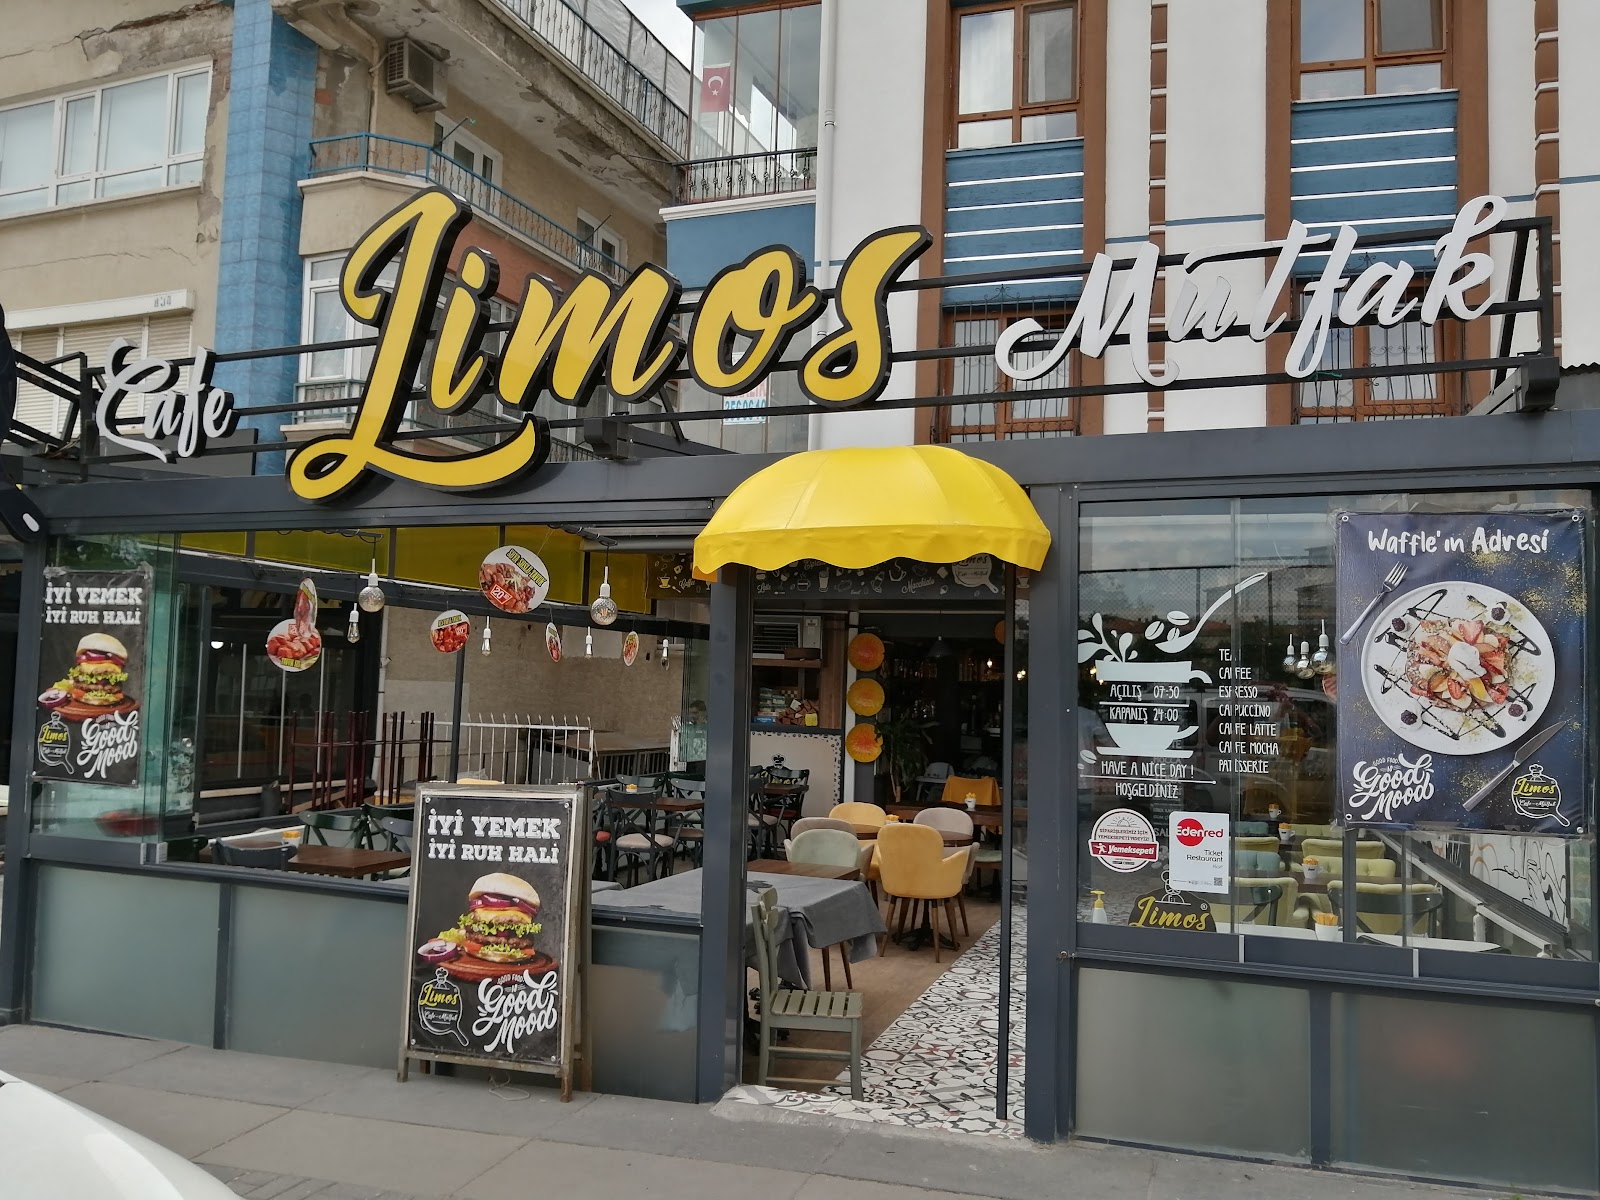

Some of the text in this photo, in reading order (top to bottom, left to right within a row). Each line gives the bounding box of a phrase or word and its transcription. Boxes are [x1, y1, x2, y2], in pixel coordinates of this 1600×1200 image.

[96, 186, 1508, 501] Cafe Limos Mutfak
[1471, 526, 1549, 554] Adresi
[45, 582, 143, 605] İYİ YEMEK
[45, 606, 141, 625] İYİ RUH HALİ
[1110, 684, 1180, 701] AÇILIŞ 07:30
[1109, 706, 1179, 725] KAPANIŞ 24:00
[39, 725, 68, 744] Limos
[77, 710, 138, 765] Good
[1250, 723, 1277, 737] LATTE
[84, 729, 138, 778] Mood
[1250, 742, 1279, 755] MOCHA
[1101, 761, 1127, 775] HAVE
[1131, 762, 1138, 776] A
[1349, 753, 1432, 807] Good
[1361, 772, 1435, 820] Mood
[1513, 778, 1556, 796] Limos
[428, 808, 561, 839] İYİ YEMEK
[1175, 825, 1224, 838] Edenred
[428, 838, 559, 864] İYİ RUH HALİ
[1107, 845, 1155, 856] Yemeksepeti
[1186, 854, 1223, 862] Restaurant
[1204, 849, 1223, 857] Ticket
[1128, 896, 1210, 930] Limos
[419, 984, 459, 1007] Limos
[472, 969, 557, 1036] Good
[483, 992, 557, 1054] Mood
